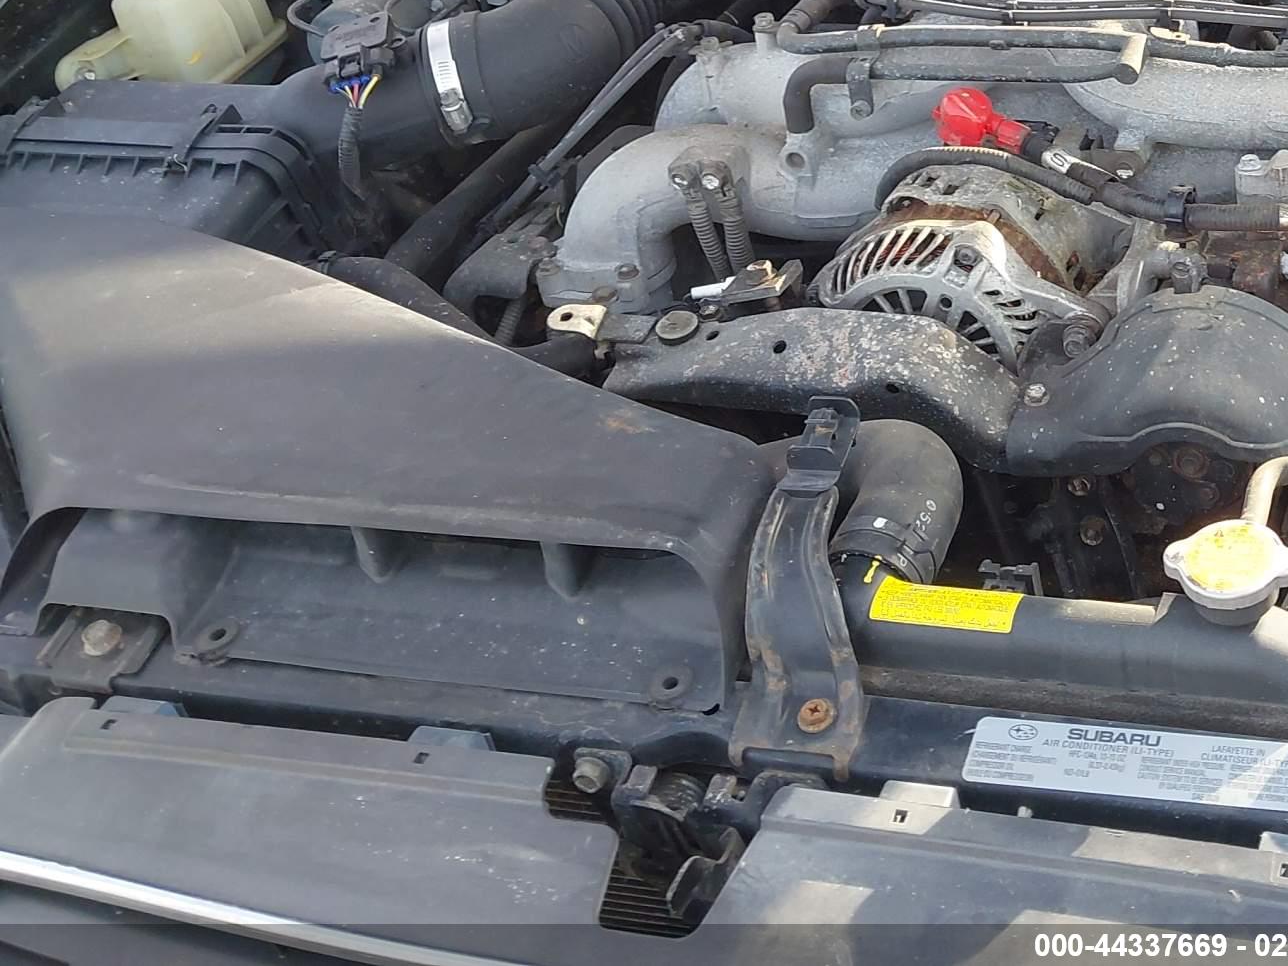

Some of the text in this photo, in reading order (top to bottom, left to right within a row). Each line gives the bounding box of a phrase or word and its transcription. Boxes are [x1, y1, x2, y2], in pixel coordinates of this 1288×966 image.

[1067, 728, 1161, 747] SUBARU
[1042, 739, 1059, 748] AIR
[1061, 740, 1128, 754] CONDITIONER
[1211, 745, 1255, 756] LAFAYETTE
[1201, 753, 1260, 765] CLIMATISEUR
